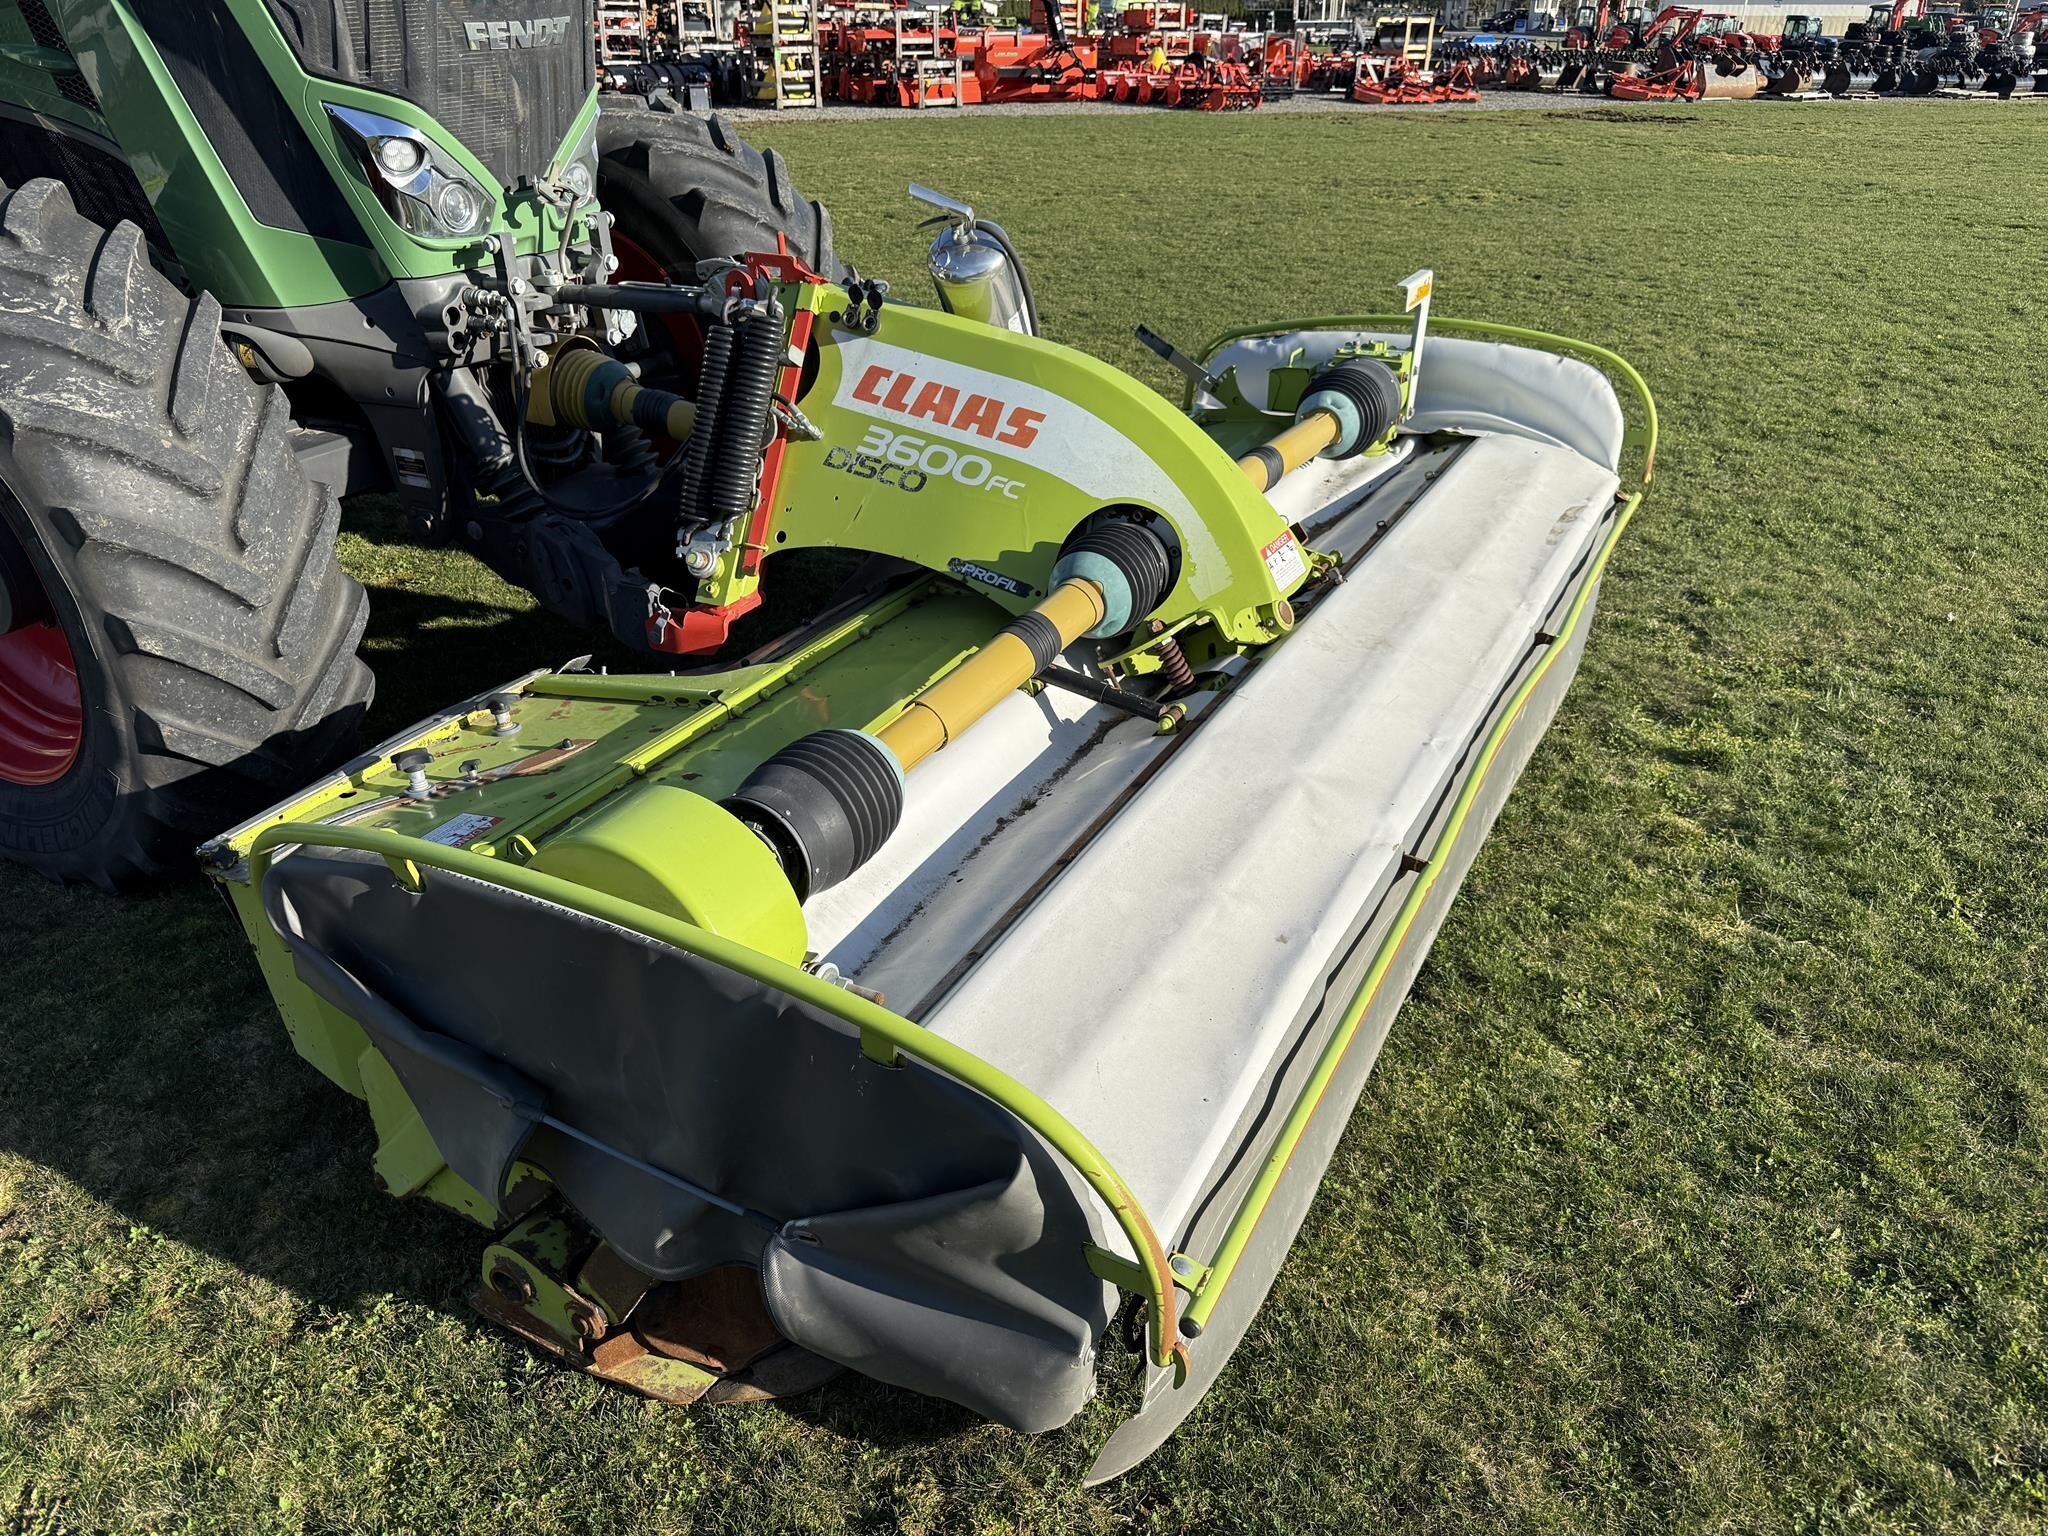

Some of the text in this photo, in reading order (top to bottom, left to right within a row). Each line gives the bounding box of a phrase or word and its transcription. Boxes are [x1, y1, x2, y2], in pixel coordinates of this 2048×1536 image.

[463, 15, 571, 51] FENDT
[851, 364, 1047, 449] CLAAS
[823, 446, 928, 493] DISCO
[961, 563, 1018, 593] PROFIL
